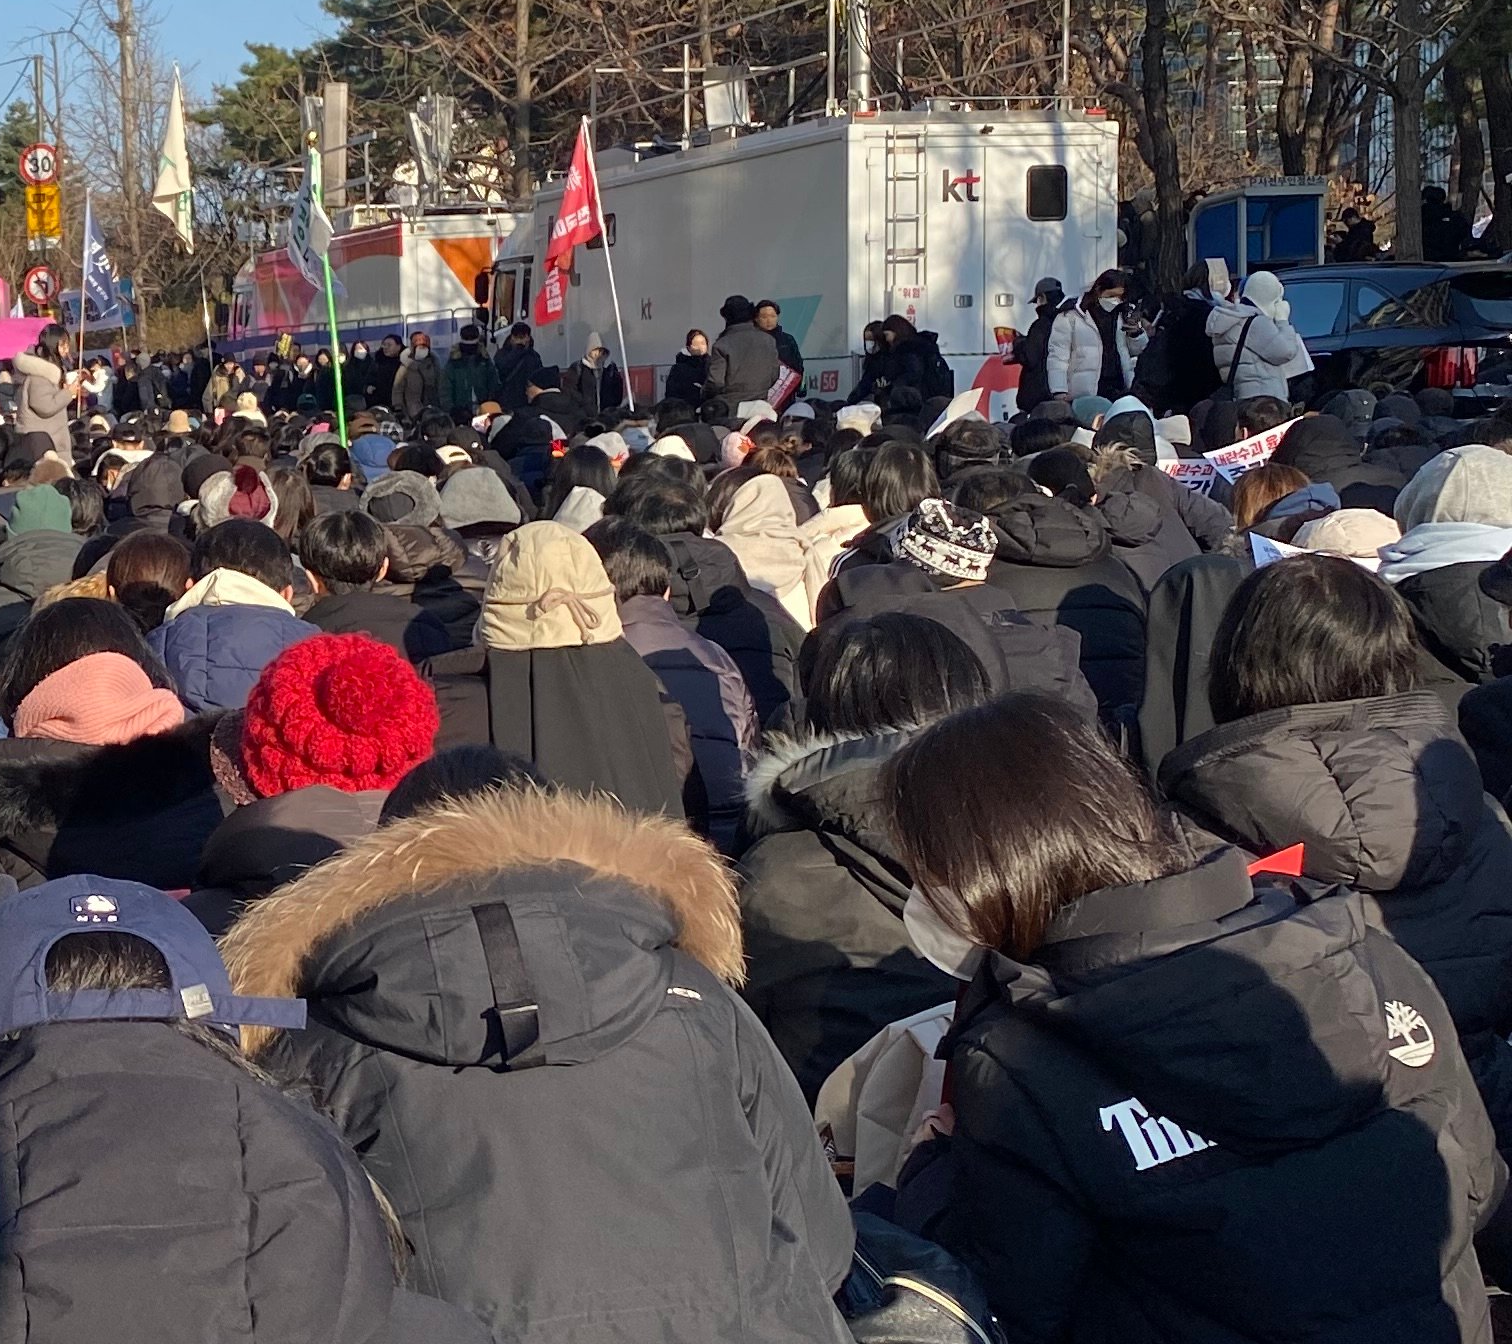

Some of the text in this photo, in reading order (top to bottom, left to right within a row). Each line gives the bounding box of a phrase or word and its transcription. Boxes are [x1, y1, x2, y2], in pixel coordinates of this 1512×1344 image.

[29, 157, 51, 173] 30
[942, 169, 981, 203] kt
[641, 298, 653, 321] kt
[808, 375, 818, 390] kt
[1213, 441, 1264, 467] 내란수괴
